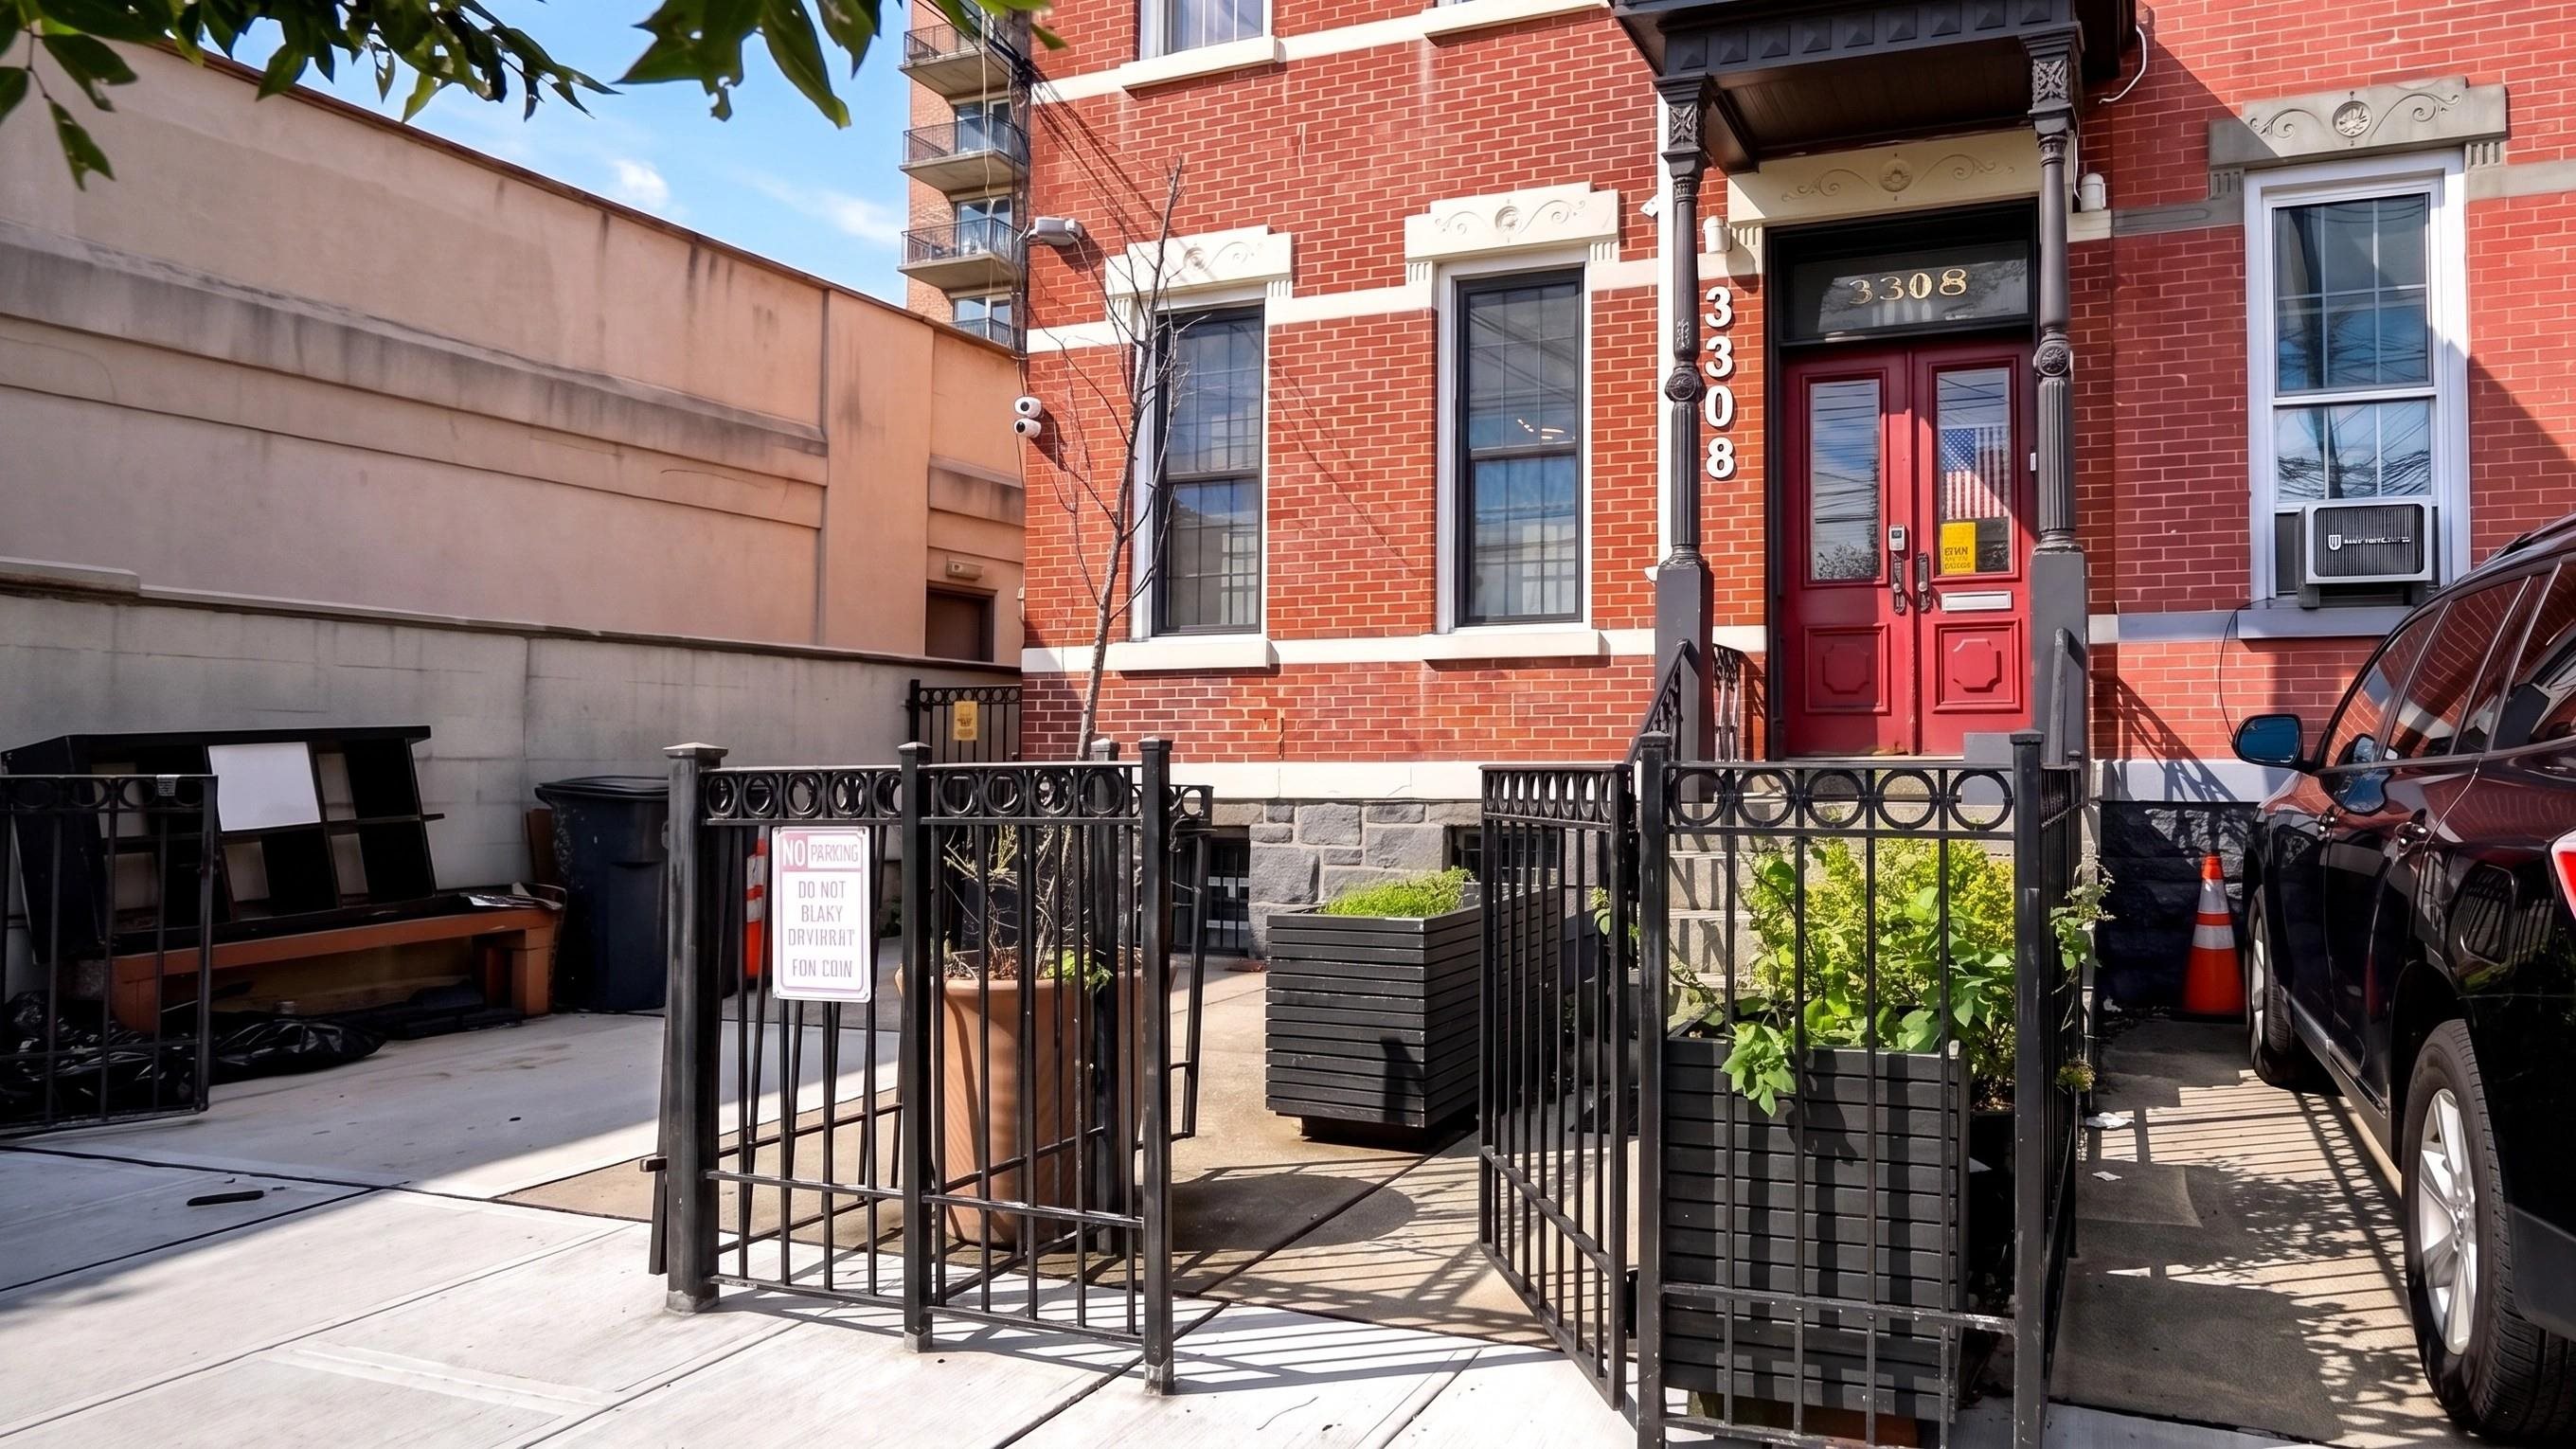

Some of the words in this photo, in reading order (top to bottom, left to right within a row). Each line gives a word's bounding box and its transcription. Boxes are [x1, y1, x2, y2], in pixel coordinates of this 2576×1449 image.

[1849, 267, 1968, 305] 3308
[1704, 286, 1735, 479] 3308
[783, 839, 806, 867] NO
[811, 844, 858, 863] PARKING
[798, 881, 815, 899] DO
[820, 881, 847, 899] NOT
